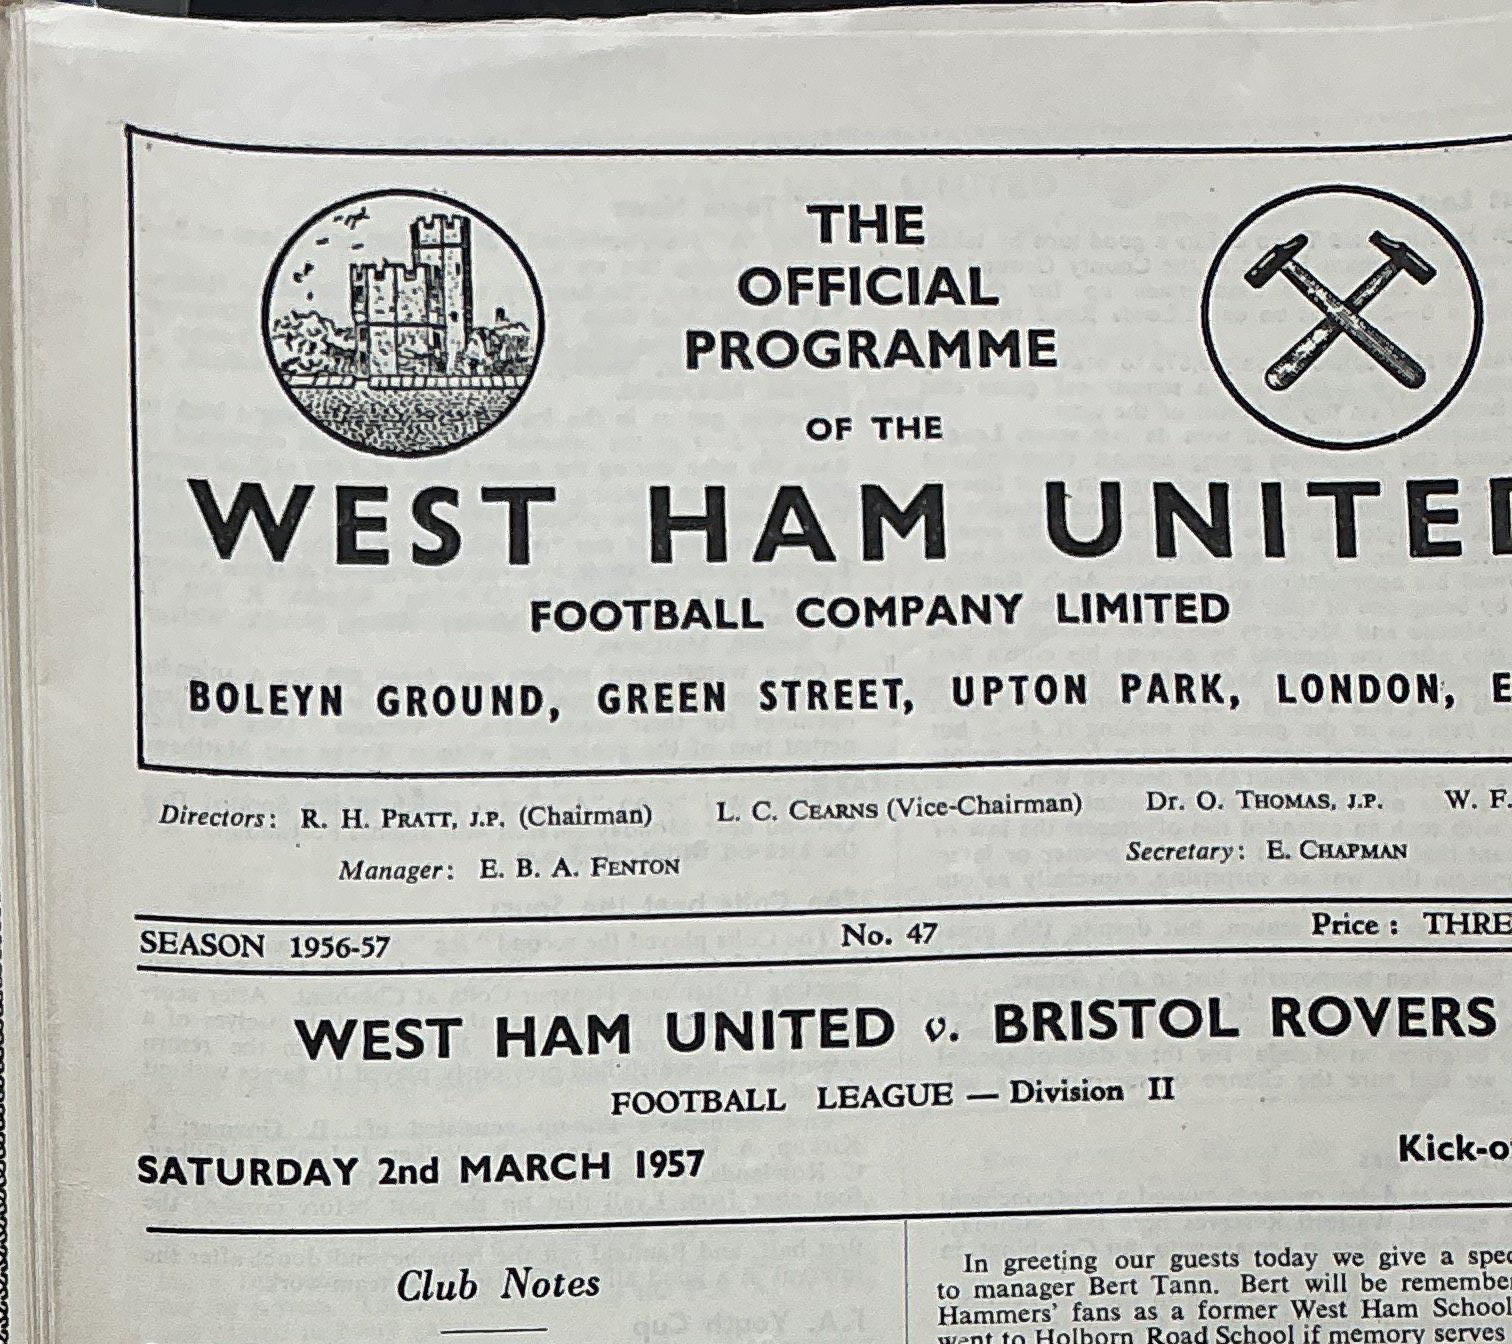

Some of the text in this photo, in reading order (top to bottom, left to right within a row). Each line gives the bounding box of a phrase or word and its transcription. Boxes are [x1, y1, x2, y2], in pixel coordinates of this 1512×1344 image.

[805, 203, 926, 246] THE
[737, 264, 1000, 307] OFFICIAL
[685, 327, 1058, 371] PROGRAMME
[805, 415, 944, 442] OF THE
[186, 476, 1512, 567] WEST HAM UNITE
[530, 591, 1230, 633] FOOTBALL COMPANY LIMITED
[189, 672, 1455, 724] BOLEYN GROUND, GREEN STREET, UPTON PARK, LONDON,
[139, 930, 391, 960] SEASON 1956-57
[841, 921, 939, 948] No. 47
[293, 995, 1497, 1061] WEST HAM UNITED v. BRISTOL ROVERS
[610, 1076, 1176, 1117] FOOTBALL LEAGUE Division II
[137, 1148, 705, 1187] SATURDAY 2nd MARCH 1957
[396, 1266, 601, 1302] Club Notes
